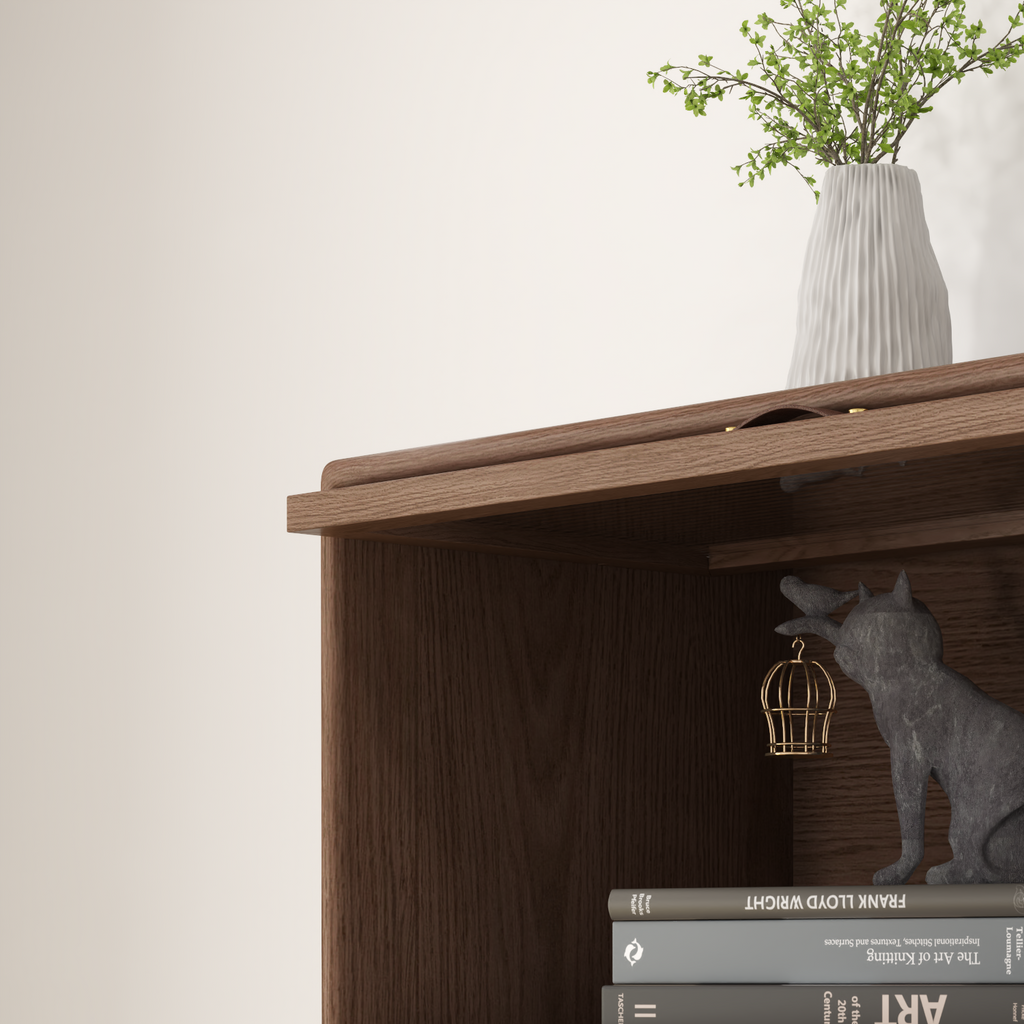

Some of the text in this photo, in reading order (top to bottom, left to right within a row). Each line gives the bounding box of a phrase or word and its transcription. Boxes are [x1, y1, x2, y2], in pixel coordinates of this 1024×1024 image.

[744, 893, 907, 911] FRANK LLOYD WRIGHT
[824, 936, 981, 948] Inspirational Stitches, Textures and Surfaces
[1004, 926, 1013, 975] Loumagne
[1015, 926, 1024, 961] Tellier-
[866, 948, 981, 966] The Art of Knitting
[851, 995, 861, 1008] of
[837, 999, 847, 1024] 20th
